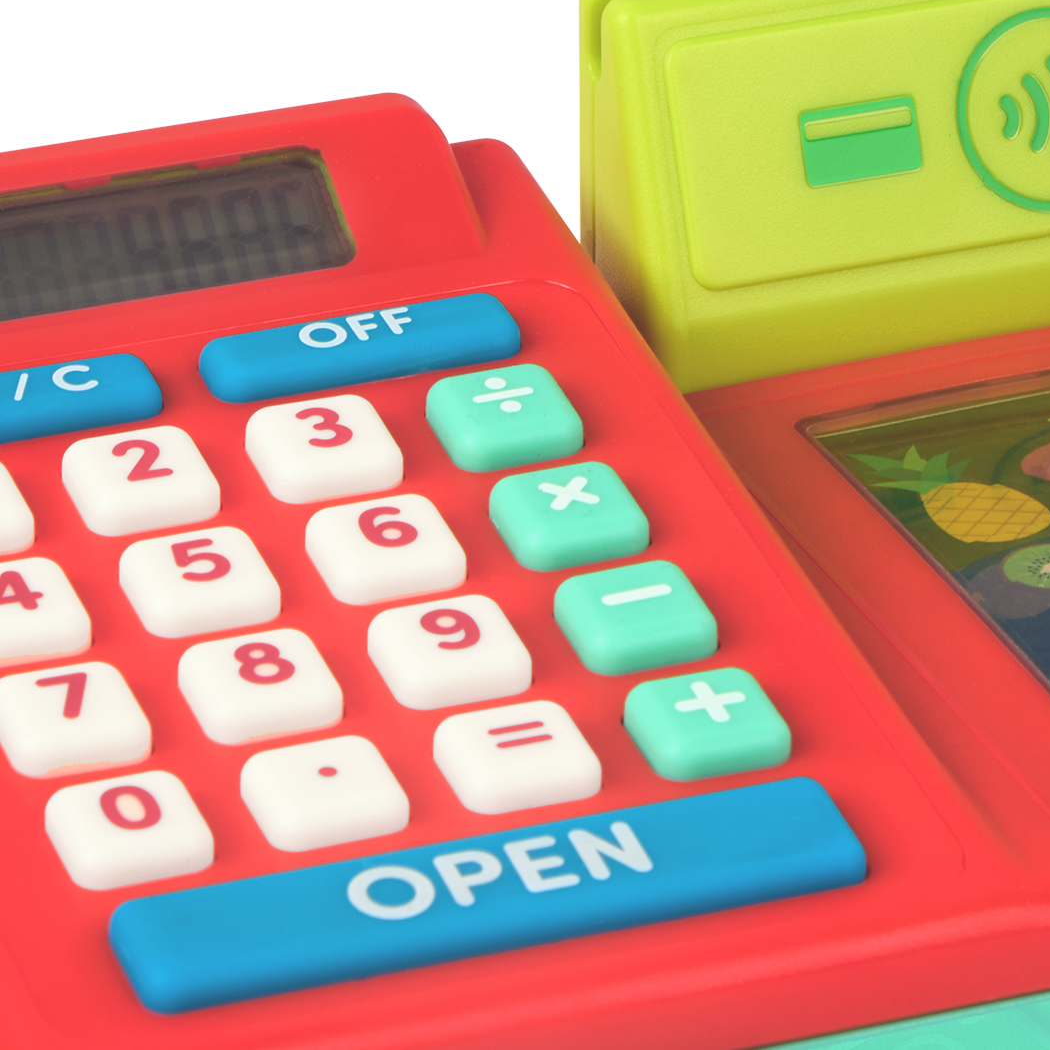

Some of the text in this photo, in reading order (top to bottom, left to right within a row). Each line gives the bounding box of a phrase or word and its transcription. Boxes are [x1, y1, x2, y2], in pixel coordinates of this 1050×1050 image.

[298, 306, 413, 348] OFF
[295, 407, 353, 448] 3
[111, 439, 174, 482] 2
[358, 506, 418, 548] 6
[171, 538, 231, 582] 5
[0, 570, 44, 611] 4
[419, 608, 481, 650] 9
[233, 642, 296, 685] 8
[35, 672, 88, 719] 7
[99, 785, 162, 830] 0
[347, 821, 653, 920] OPEN
